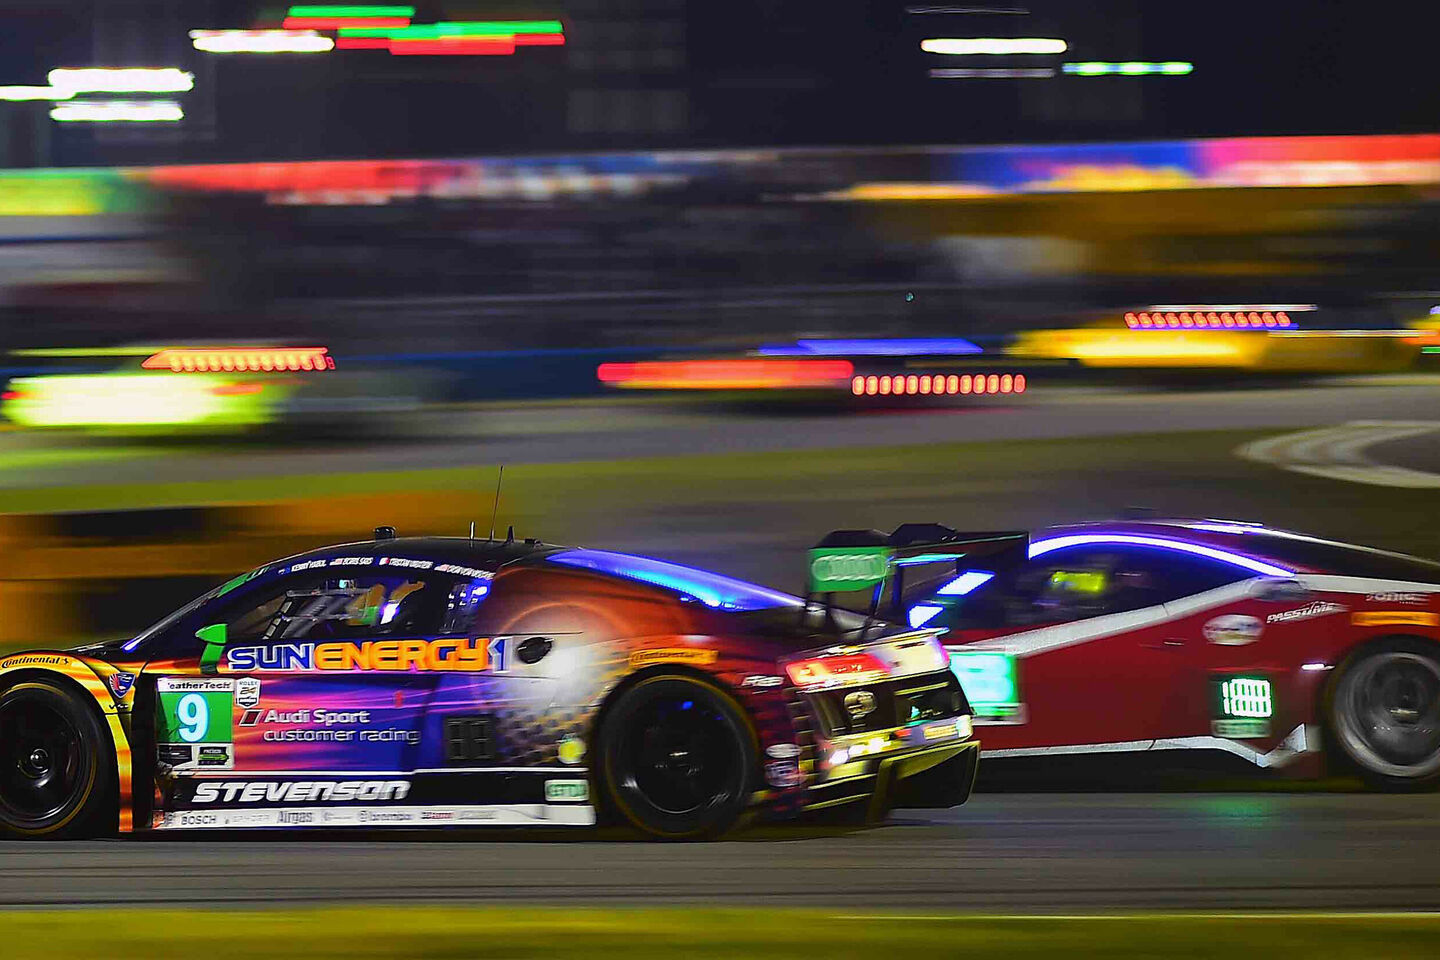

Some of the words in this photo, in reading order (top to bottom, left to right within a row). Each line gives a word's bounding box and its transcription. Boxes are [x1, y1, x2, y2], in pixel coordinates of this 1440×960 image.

[2, 656, 60, 668] Continental
[177, 693, 208, 742] 9
[264, 710, 310, 723] Audi
[313, 709, 371, 726] Sport
[263, 729, 356, 741] customer
[360, 728, 422, 745] racing
[192, 781, 411, 803] STEVENSON
[181, 815, 216, 825] BOSCH
[277, 811, 313, 824] Airgas
